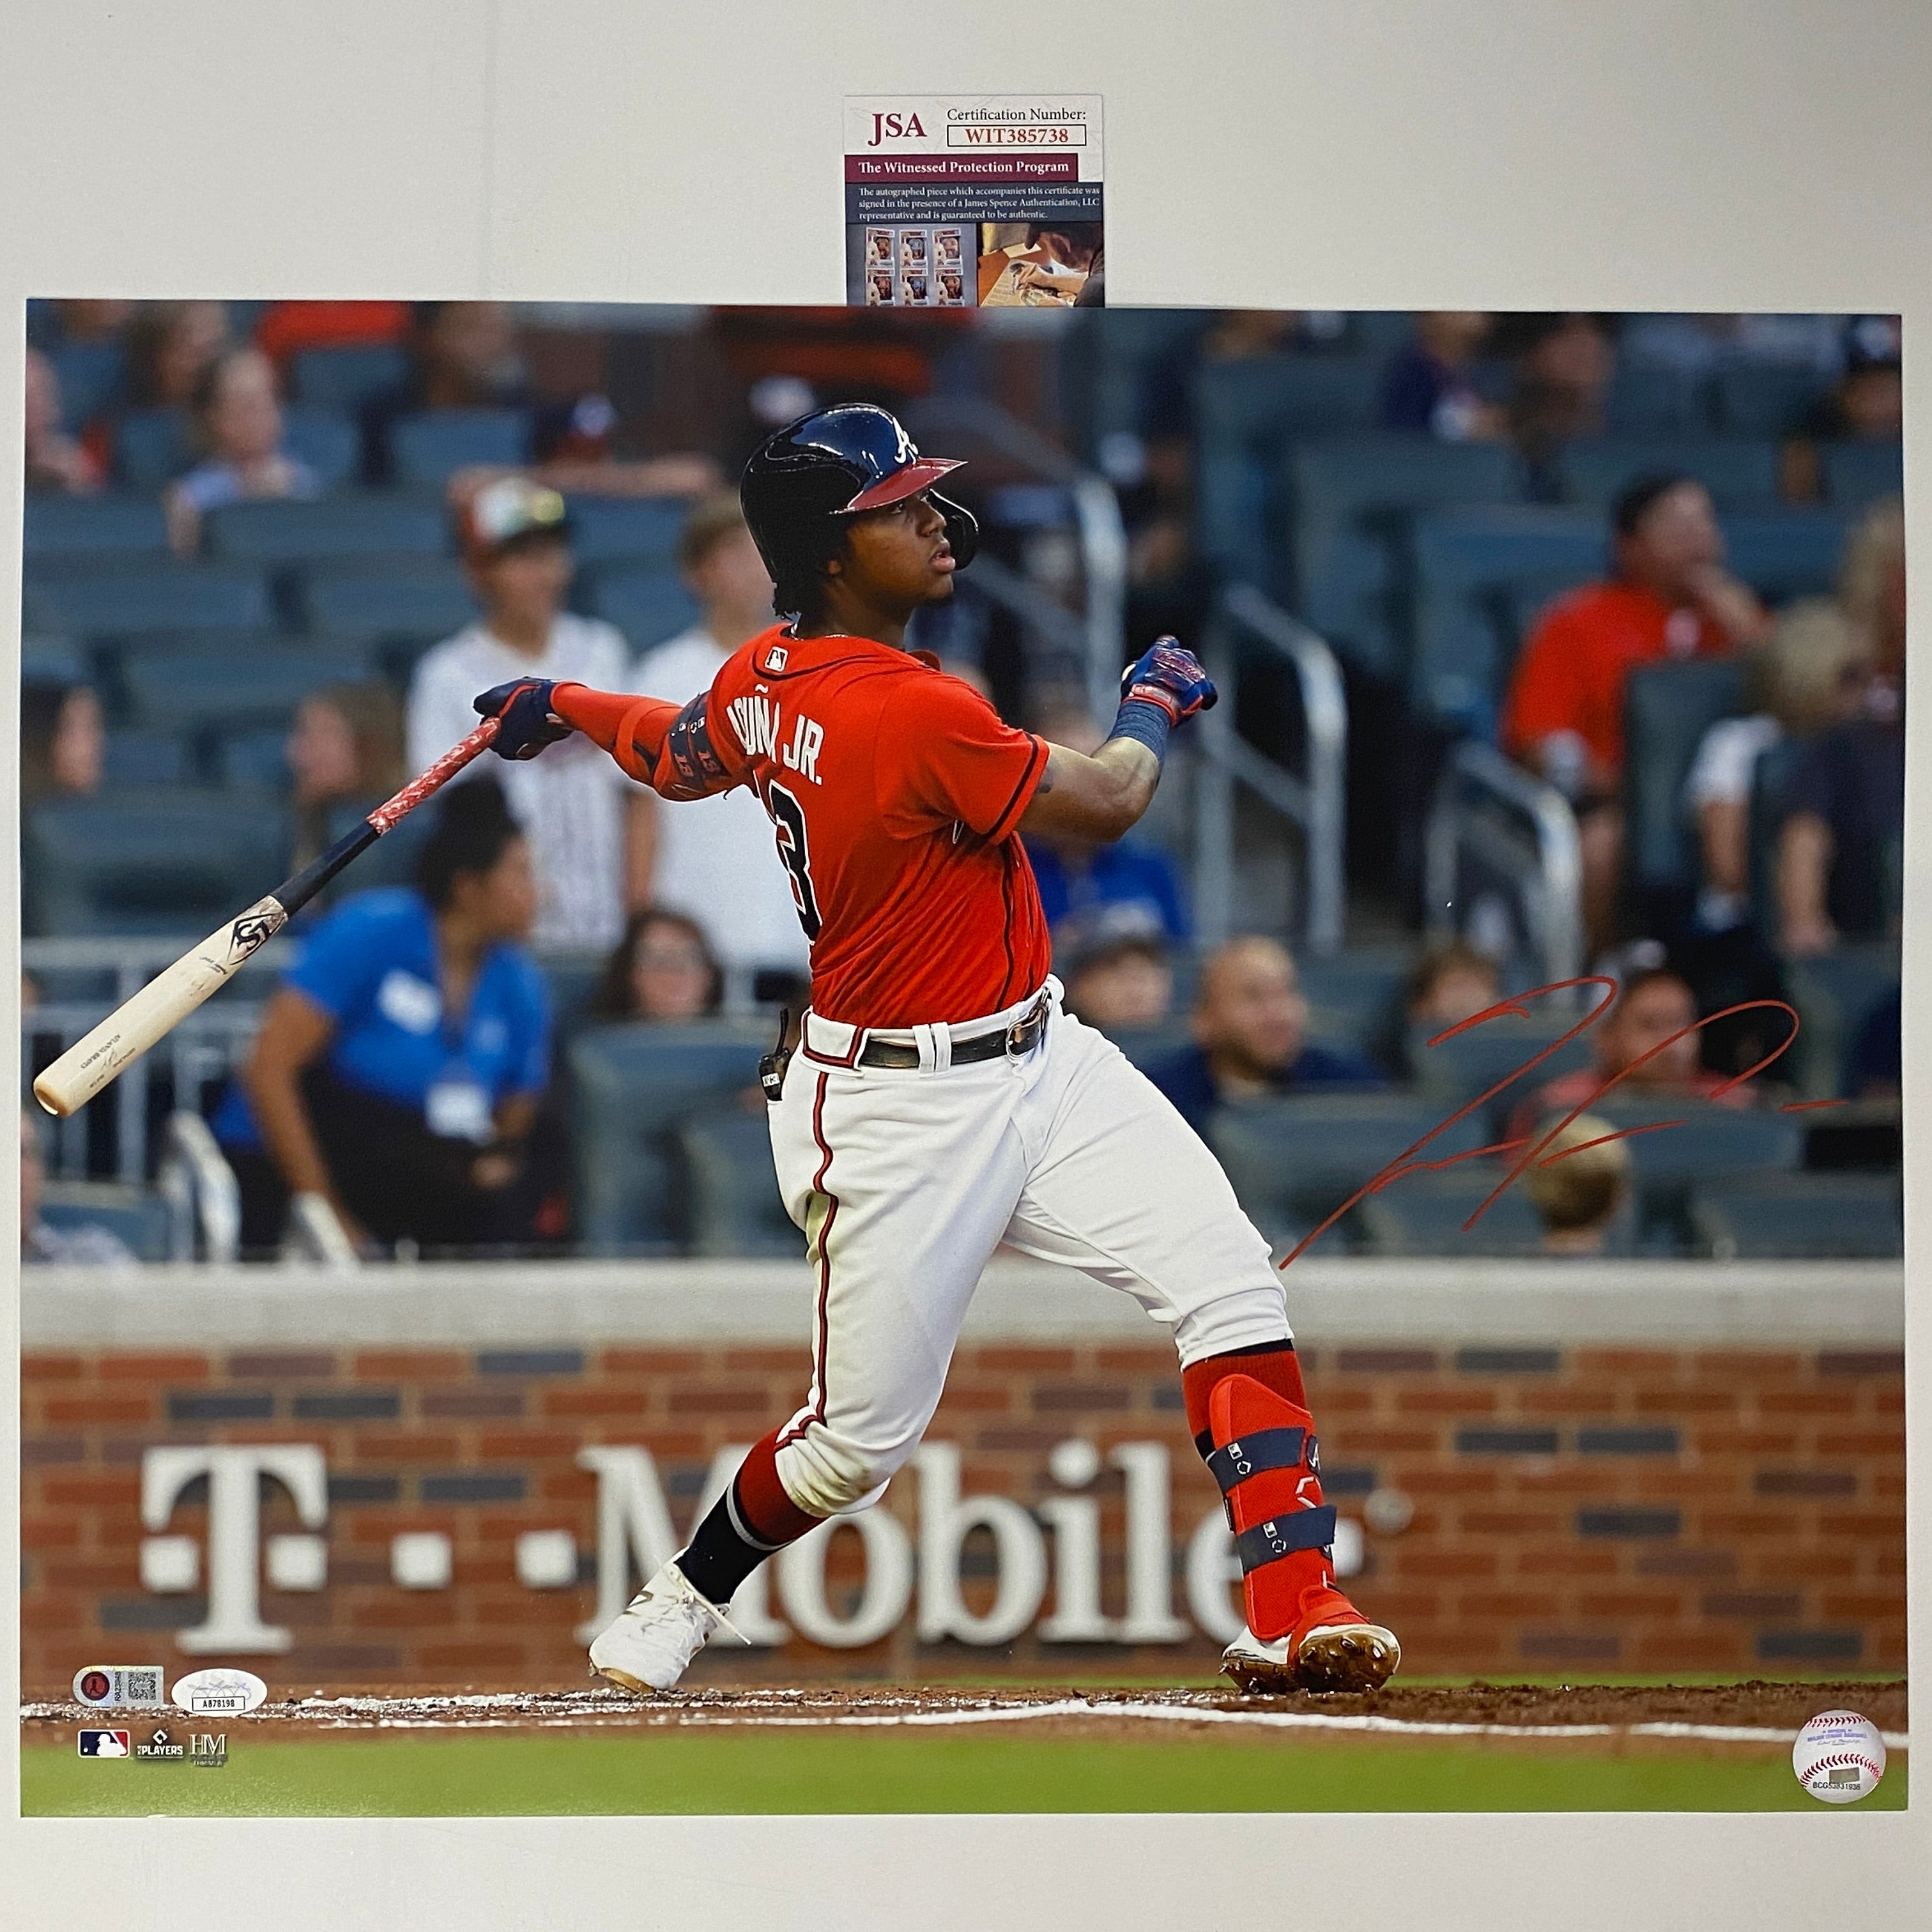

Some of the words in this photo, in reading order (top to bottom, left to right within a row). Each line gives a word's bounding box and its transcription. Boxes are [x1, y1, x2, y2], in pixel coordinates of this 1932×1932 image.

[947, 108, 1026, 120] Certification
[1030, 107, 1086, 120] Number:
[868, 112, 927, 146] JSA
[965, 128, 1069, 144] WIT385738
[858, 161, 881, 174] The
[884, 161, 946, 174] Witnessed
[949, 160, 1013, 173] Protection
[1016, 161, 1069, 176] Program
[859, 187, 874, 195] The
[875, 187, 925, 197] autographed
[927, 187, 947, 197] piece
[949, 187, 974, 195] which
[975, 187, 1027, 197] accompanies
[1028, 187, 1043, 195] this
[1045, 186, 1084, 195] certificate
[859, 199, 885, 210] signed
[887, 199, 894, 208] in
[897, 199, 909, 208] the
[911, 201, 946, 210] presence
[947, 198, 958, 208] of
[965, 199, 988, 208] James
[990, 198, 1017, 209] Spence
[1020, 197, 1081, 208] Authentication,
[1082, 197, 1100, 206] LLC
[859, 211, 914, 222] representative
[916, 211, 931, 219] and
[941, 211, 985, 221] guaranteed
[997, 210, 1008, 218] be
[1009, 210, 1048, 219] authentic.
[783, 713, 824, 786] JR.
[141, 1745, 183, 1756] PLAYERS
